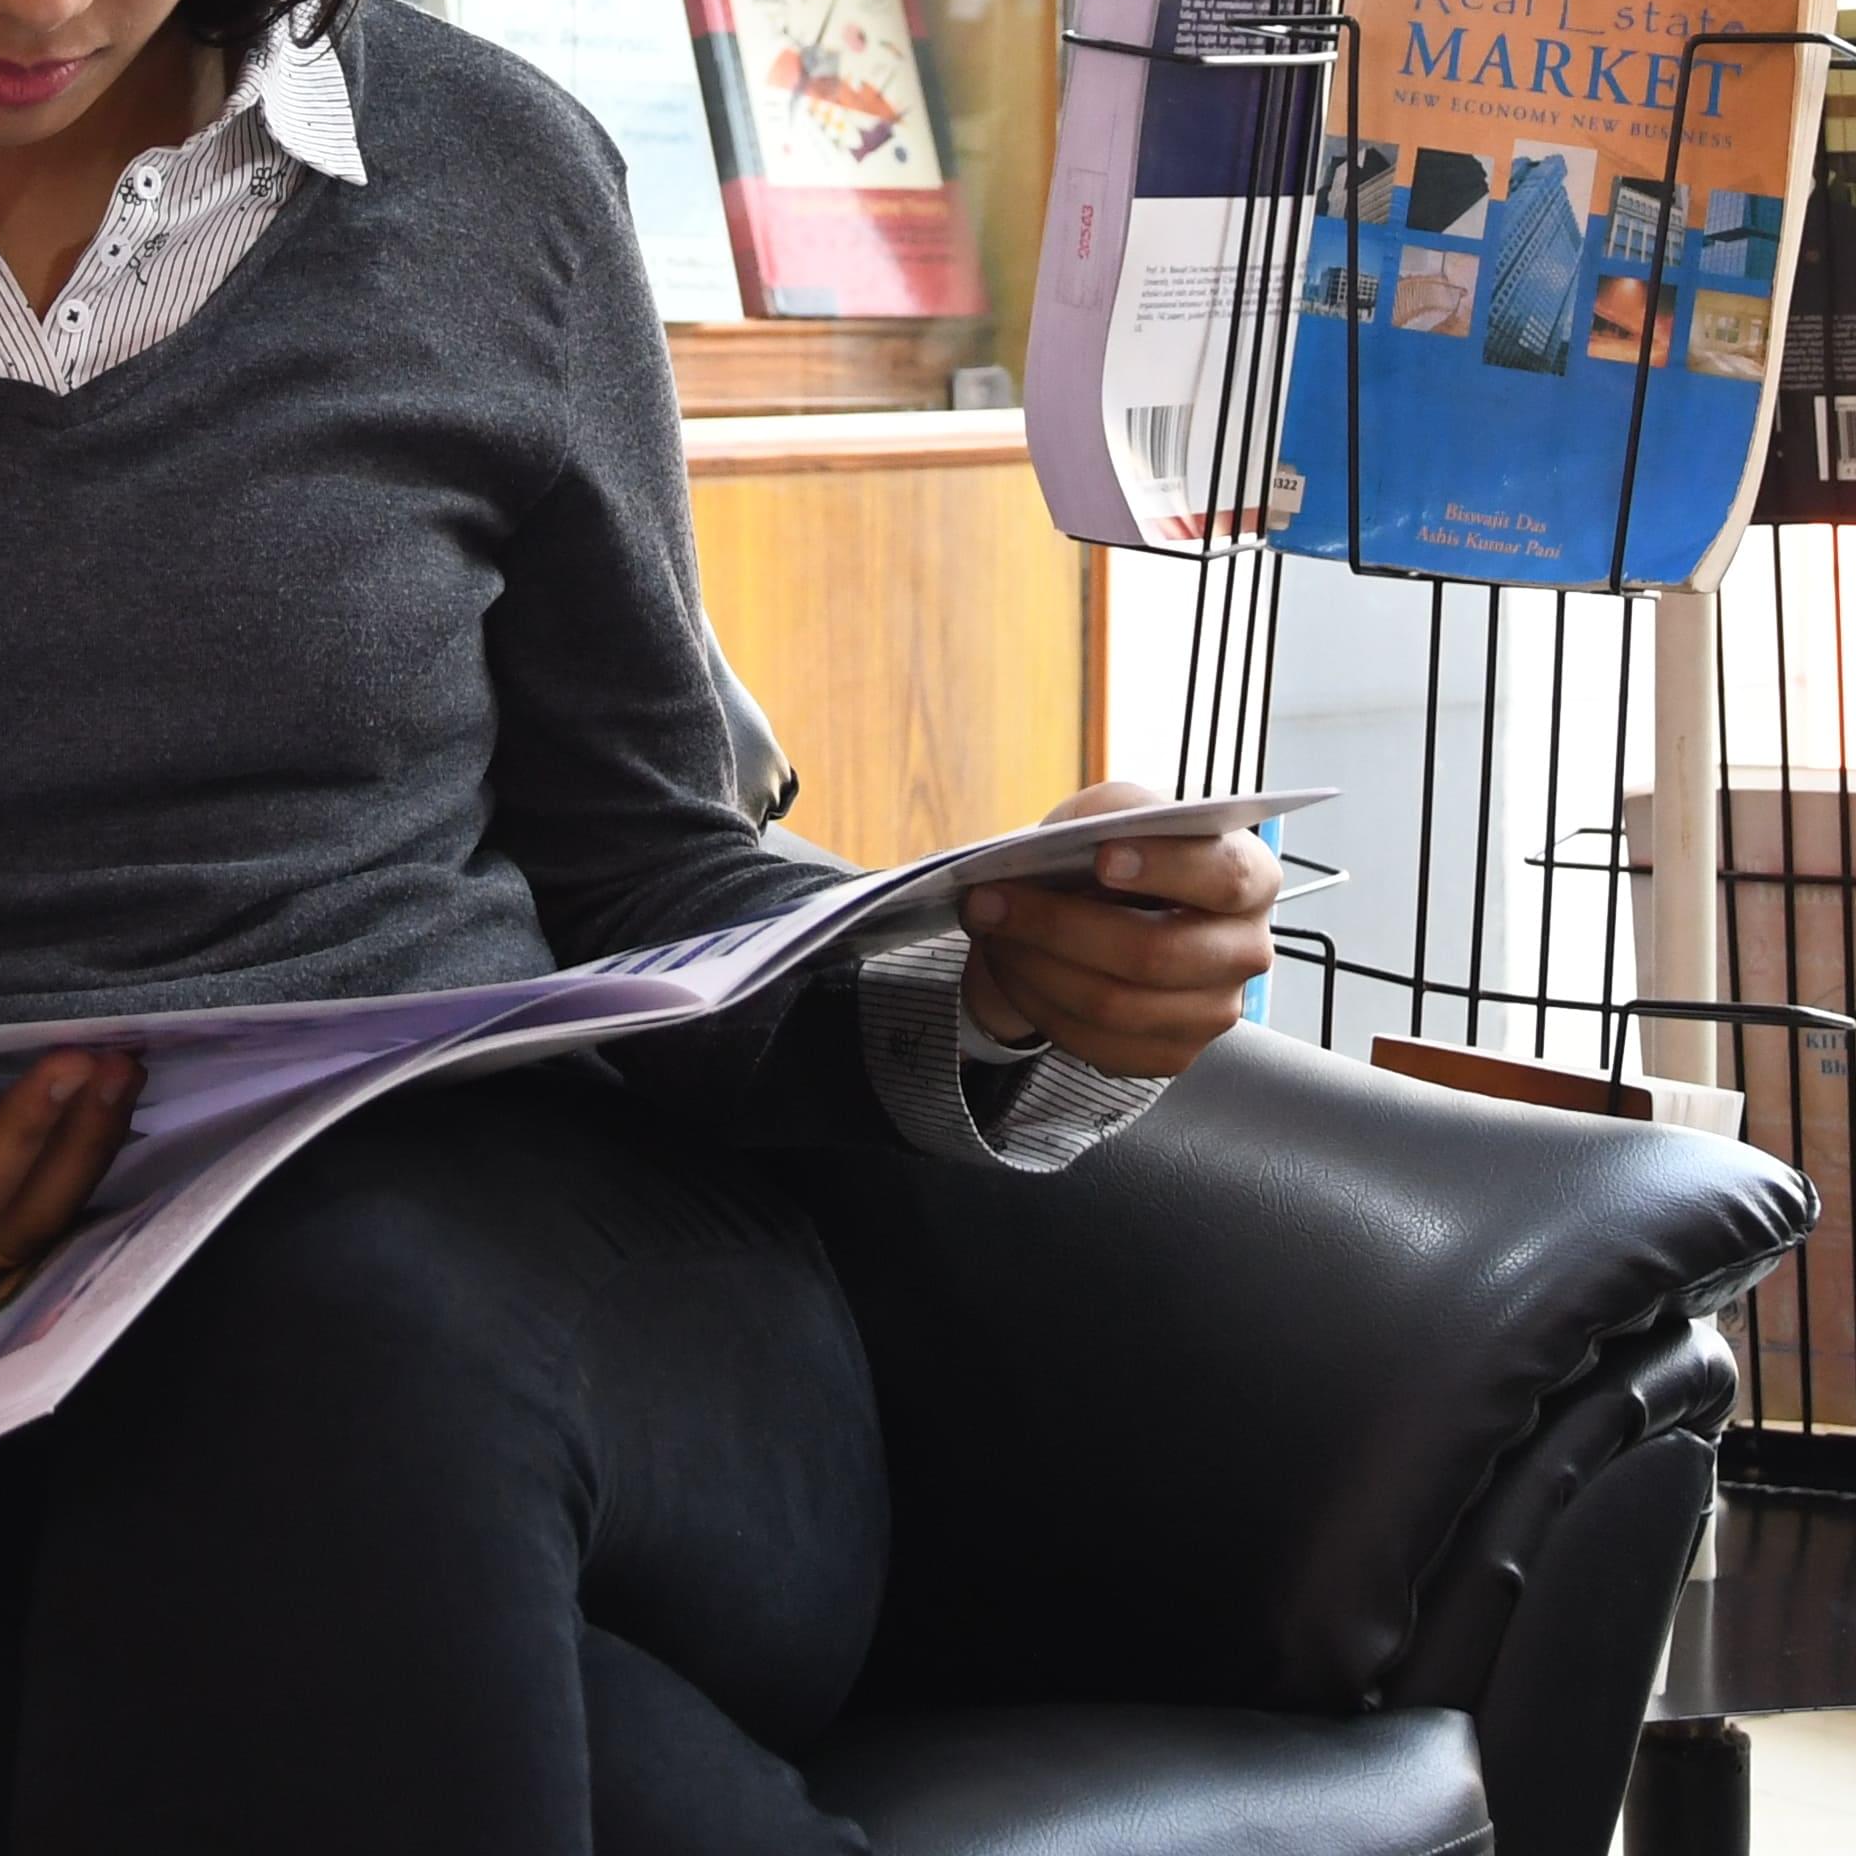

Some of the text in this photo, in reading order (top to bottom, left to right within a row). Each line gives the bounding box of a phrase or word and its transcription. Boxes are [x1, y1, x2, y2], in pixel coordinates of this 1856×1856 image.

[1398, 21, 1743, 118] MARKET
[1394, 88, 1733, 149] NEW ECONOMY NEW BUSNESS
[1445, 503, 1547, 534] Biswajit Das
[1416, 526, 1562, 561] Ashis Kumar Pani
